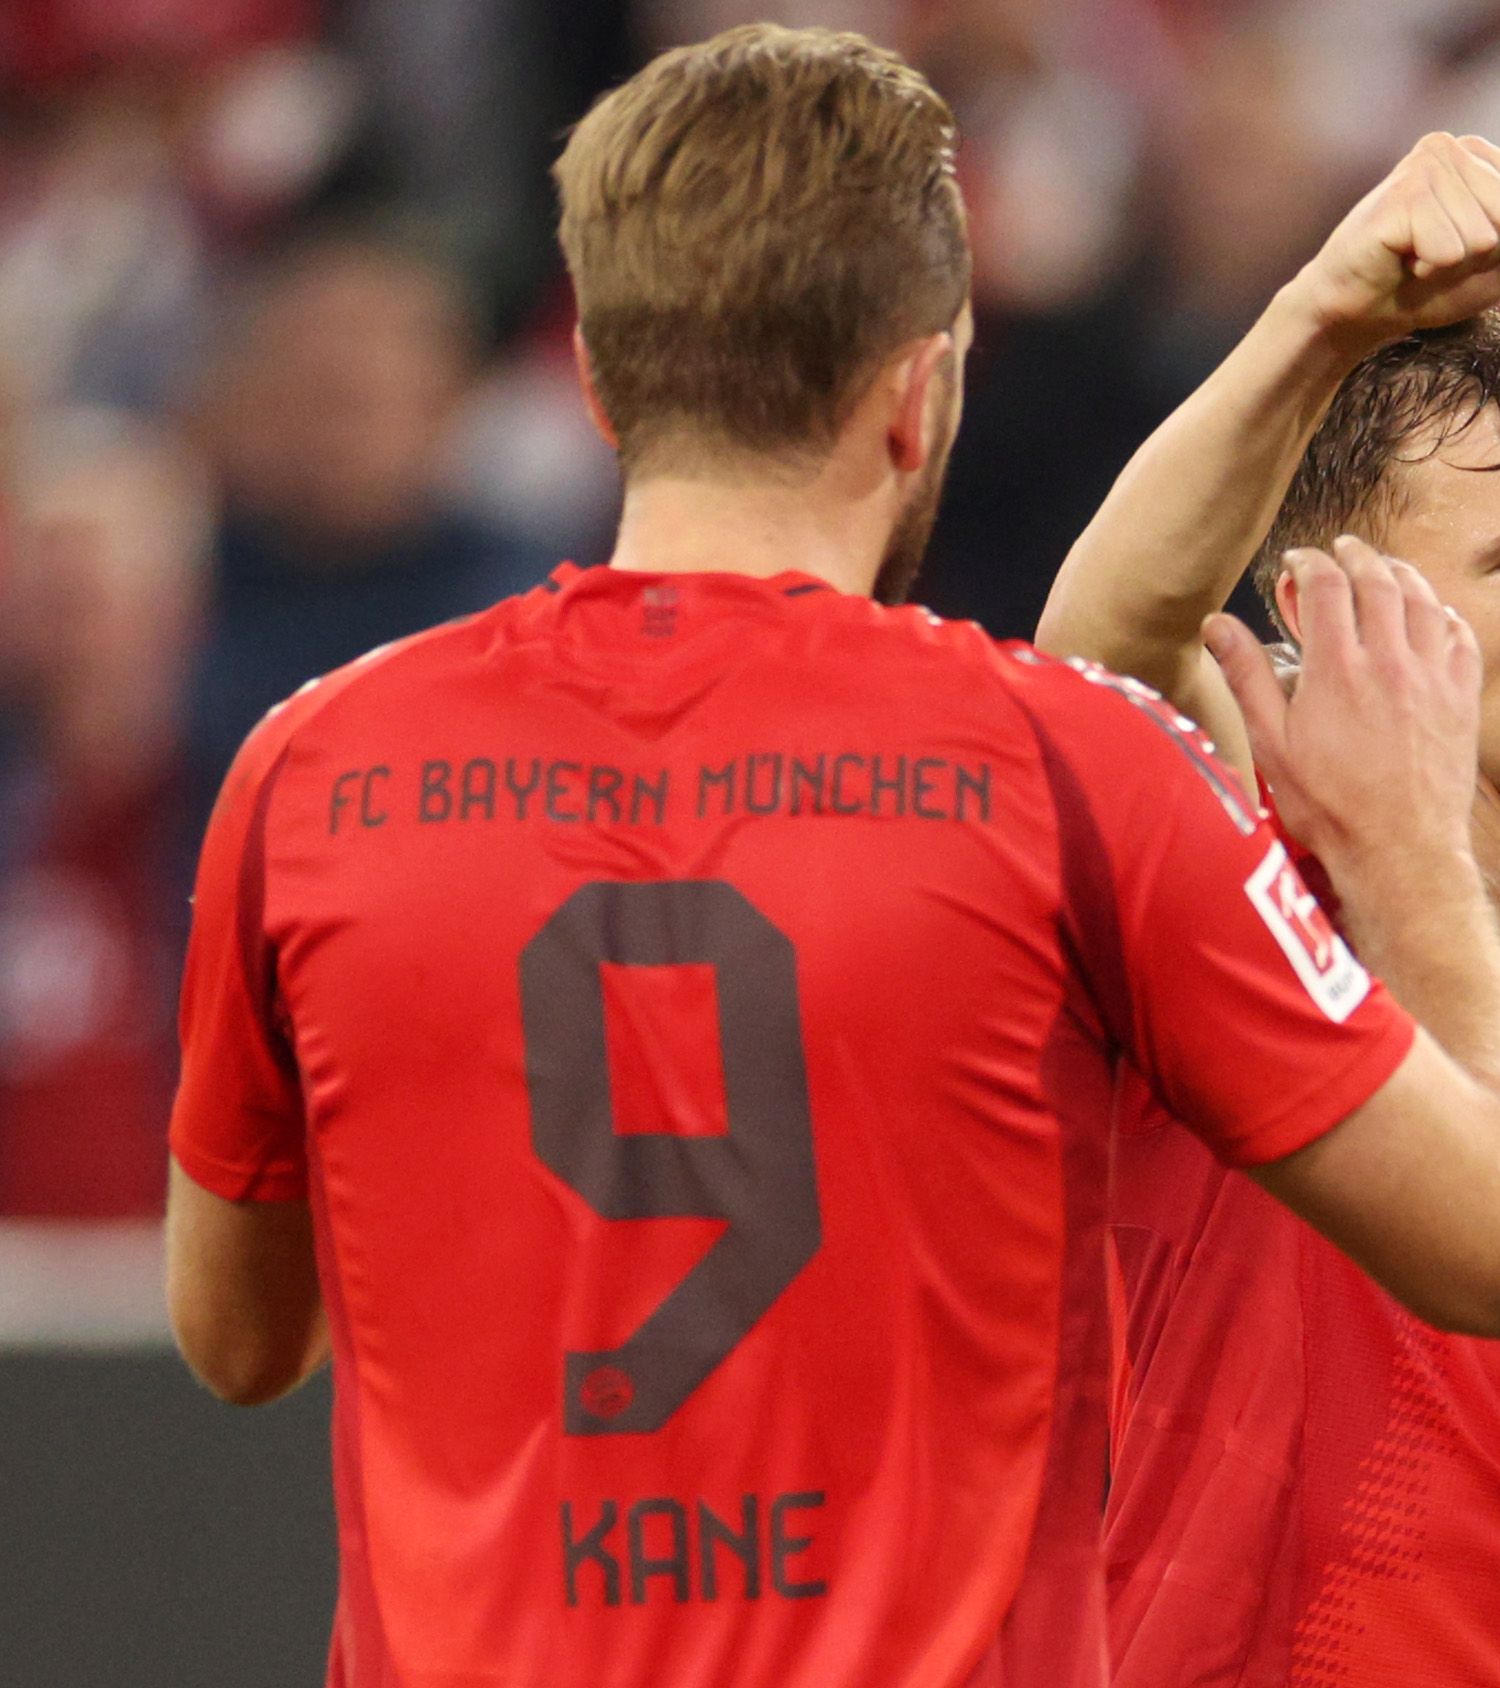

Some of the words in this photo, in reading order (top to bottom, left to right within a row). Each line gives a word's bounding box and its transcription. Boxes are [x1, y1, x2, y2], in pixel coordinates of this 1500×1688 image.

[328, 764, 391, 835] FC
[418, 757, 670, 826] BAYERN
[695, 751, 992, 824] MÜNCHEN
[517, 879, 823, 1436] 9
[560, 1492, 829, 1607] KANE
